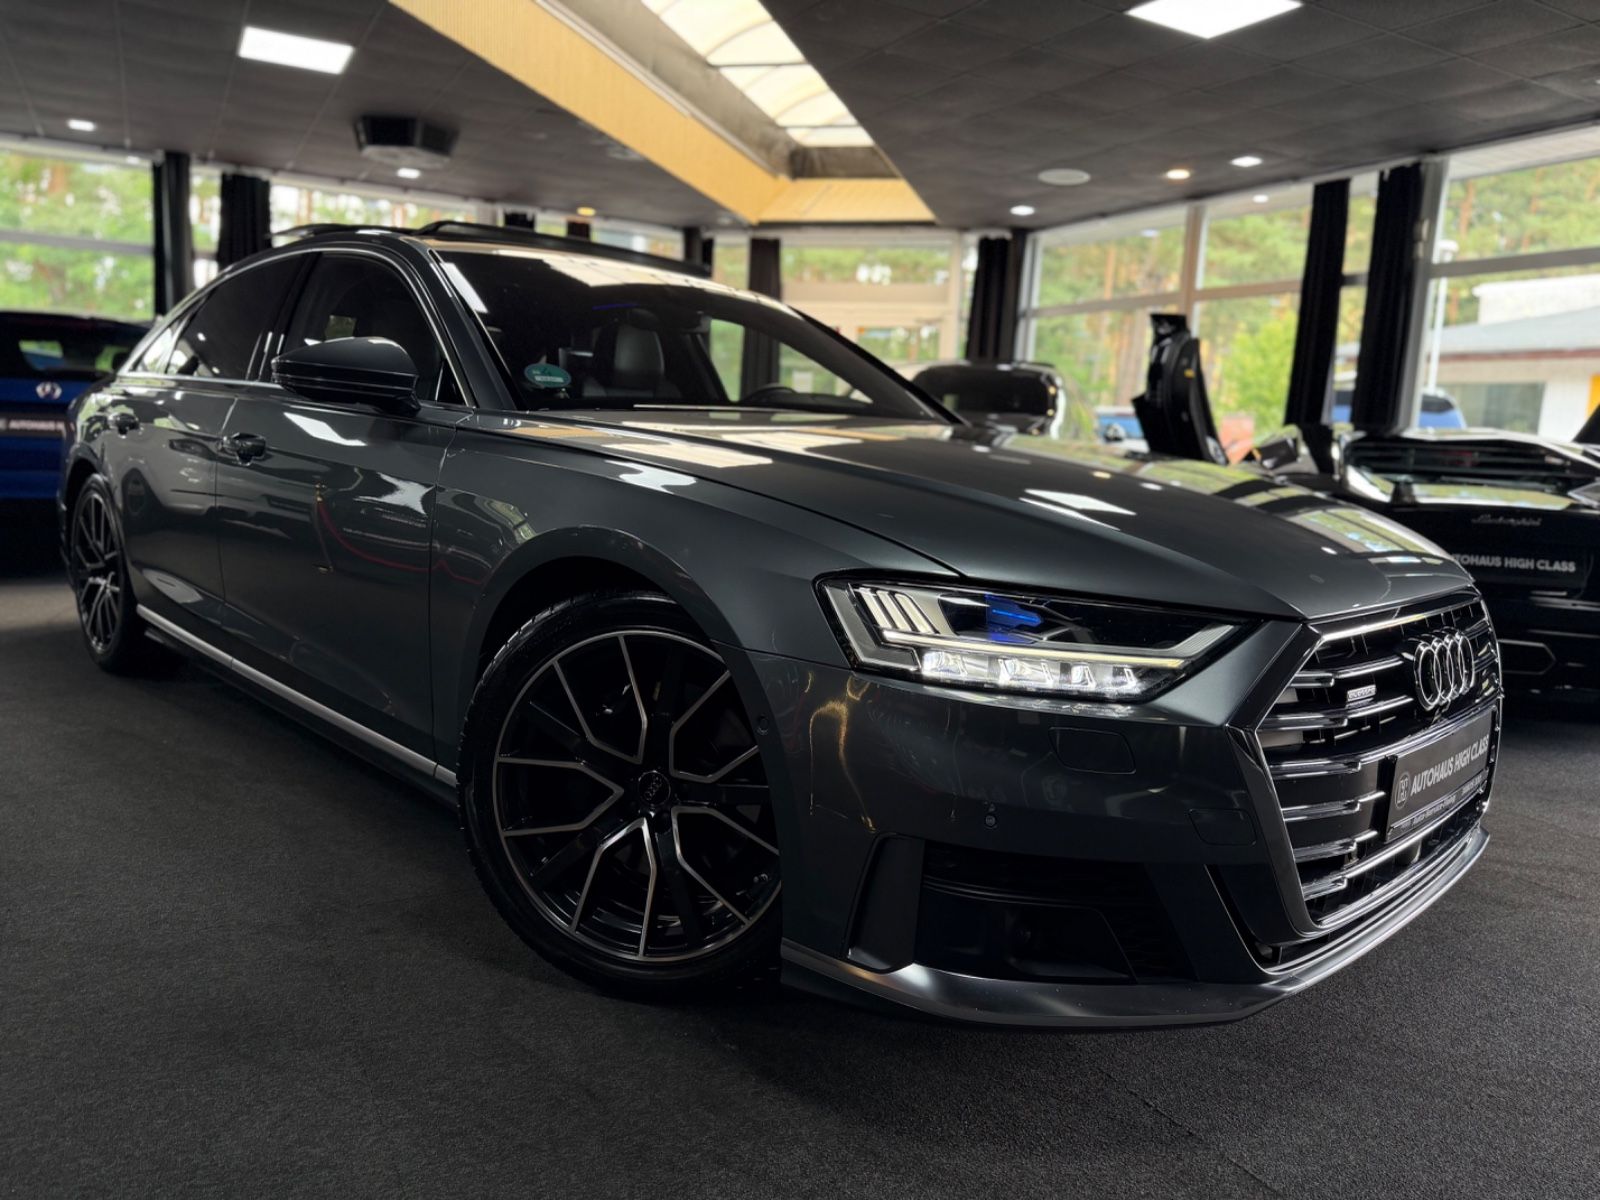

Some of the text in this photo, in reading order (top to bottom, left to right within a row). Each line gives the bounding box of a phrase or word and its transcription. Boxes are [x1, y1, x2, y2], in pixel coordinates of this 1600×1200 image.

[1453, 554, 1576, 572] TOHAUS HIGH CLASS
[1411, 756, 1454, 796] AUTOHAUS
[1454, 747, 1472, 773] HIGH
[1471, 734, 1489, 761] CLASS
